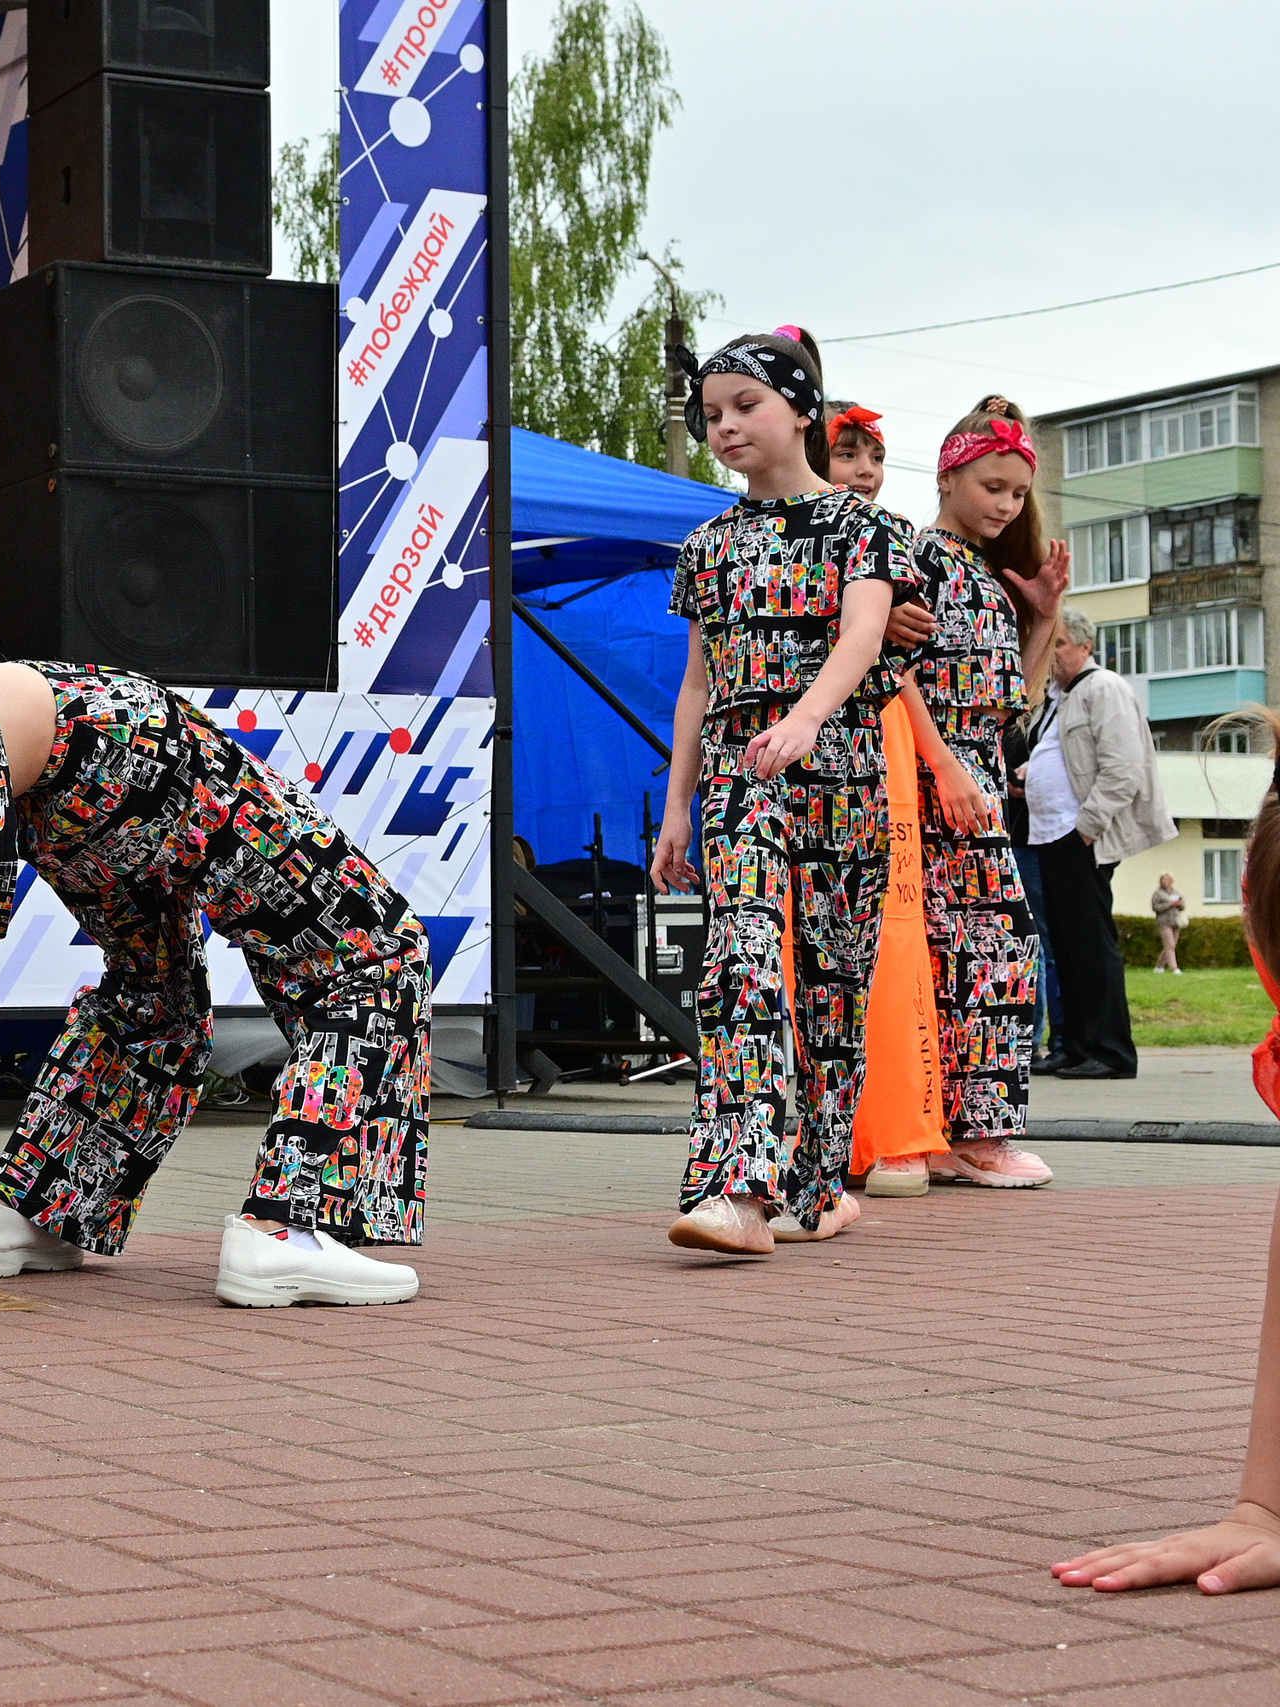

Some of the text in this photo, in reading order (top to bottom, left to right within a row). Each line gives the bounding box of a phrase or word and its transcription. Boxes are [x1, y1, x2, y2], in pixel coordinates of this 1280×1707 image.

[346, 212, 455, 387] #побеждай
[353, 502, 444, 648] #дерзай
[896, 883, 917, 904] YOU
[917, 1018, 933, 1114] POSITIVE
